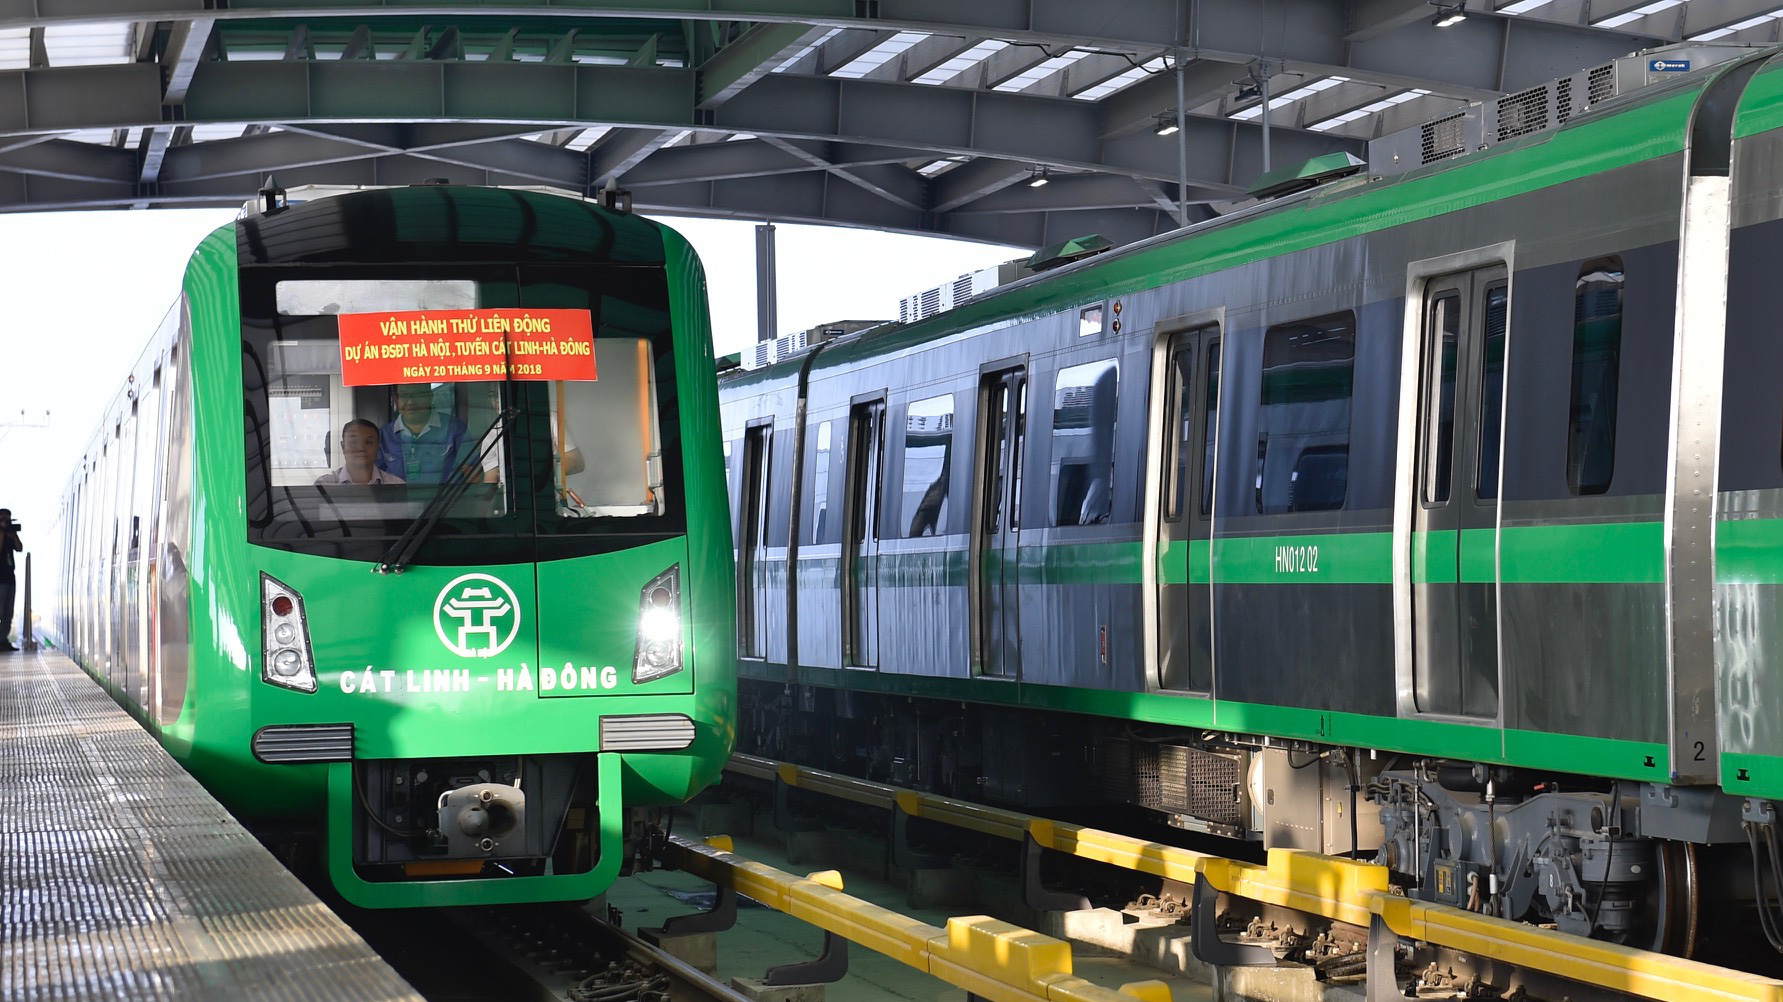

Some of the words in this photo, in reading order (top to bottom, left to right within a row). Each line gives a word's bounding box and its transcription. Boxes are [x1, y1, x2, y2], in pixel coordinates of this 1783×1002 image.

[380, 316, 408, 339] VẬN
[410, 315, 448, 335] HÀNH
[449, 313, 478, 334] THỬ
[480, 313, 511, 333] LIÊN
[513, 313, 551, 336] ĐỘNG
[345, 343, 362, 364] DỰ
[363, 341, 379, 360] ÁN
[381, 343, 410, 359] ĐSĐT
[412, 338, 428, 357] HÀ
[492, 336, 512, 355] CÁT
[560, 337, 591, 356] ĐÔNG
[403, 363, 431, 378] NGÀY
[433, 365, 447, 377] 20
[447, 361, 483, 376] THÁNG
[484, 364, 491, 375] 9
[517, 364, 543, 375] 2018
[1275, 545, 1306, 573] HN012
[1306, 545, 1319, 573] 02
[340, 665, 396, 694] CÁT
[406, 669, 470, 693] LINH
[496, 662, 533, 692] HÀ
[540, 661, 617, 690] ĐÔNG
[1693, 740, 1706, 762] 2
